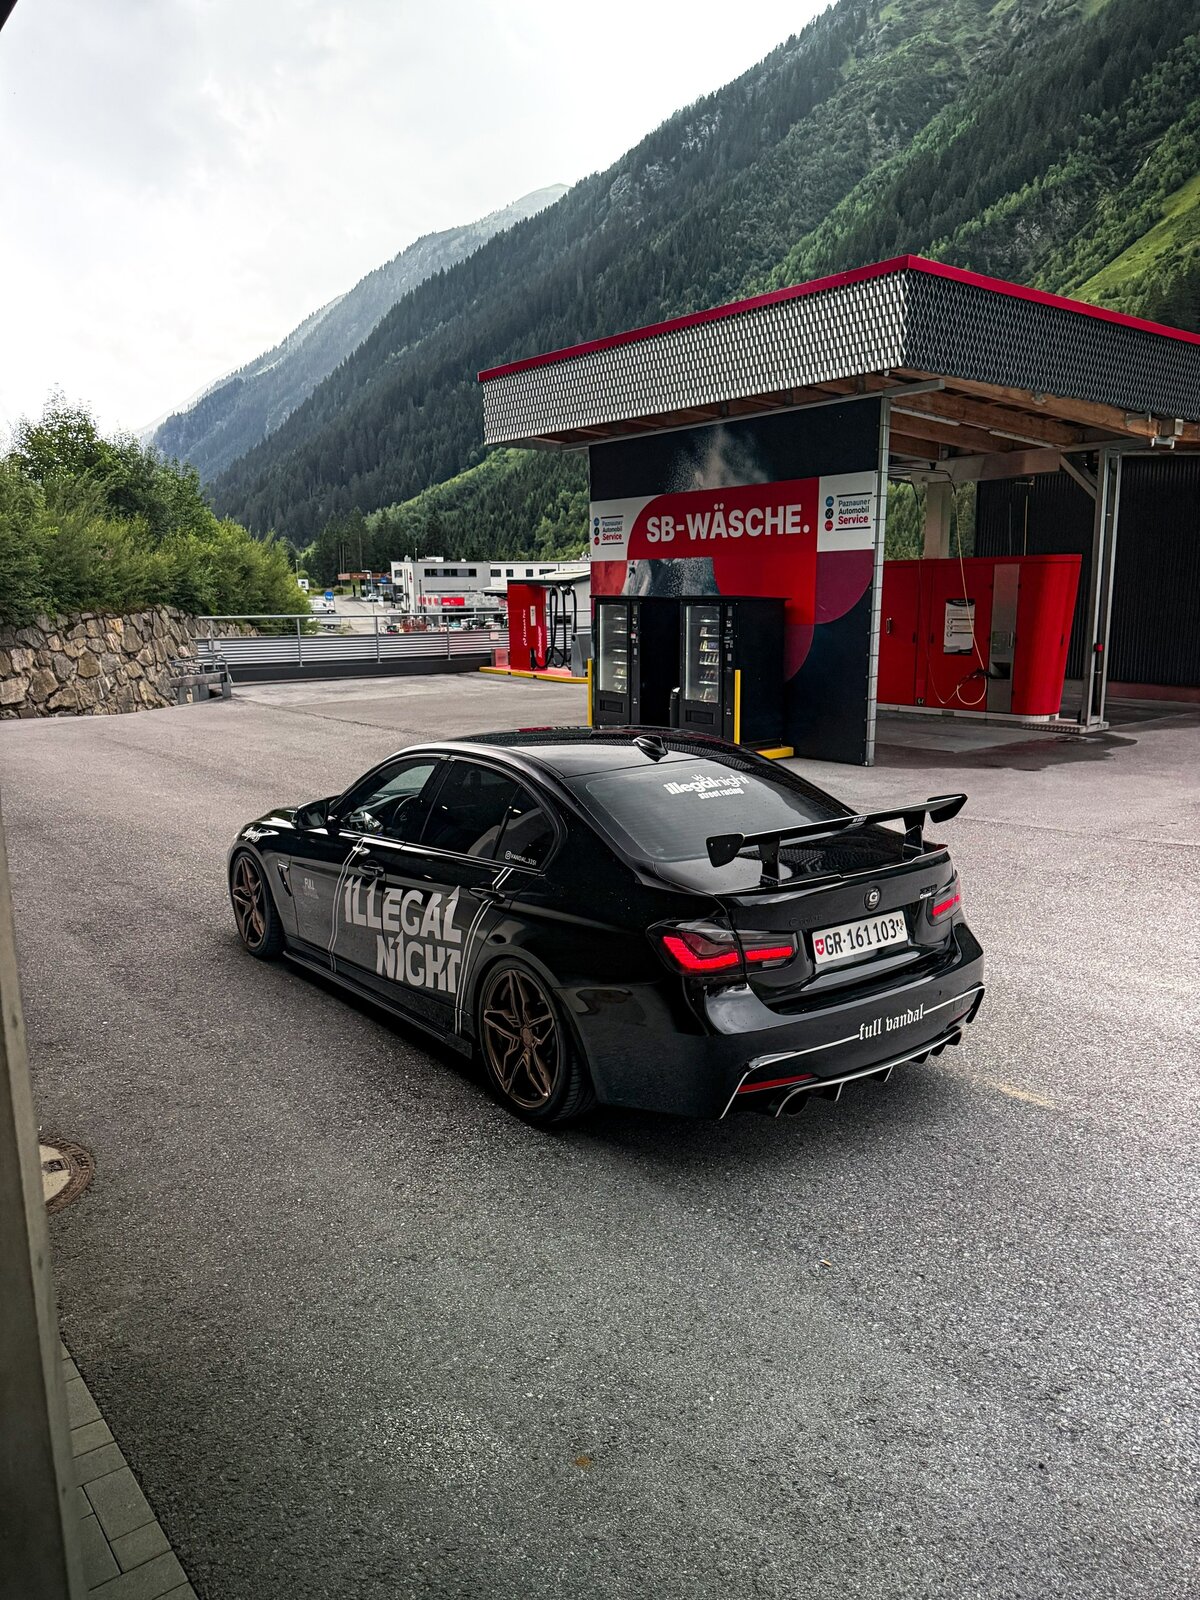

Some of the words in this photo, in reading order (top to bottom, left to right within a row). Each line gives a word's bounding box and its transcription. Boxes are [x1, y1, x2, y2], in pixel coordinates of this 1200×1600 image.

[838, 498, 871, 507] Paznauner
[838, 506, 870, 515] Automobil
[646, 503, 810, 543] SB-WÄSCHE.
[838, 514, 869, 525] Service
[602, 533, 622, 541] Service
[698, 790, 721, 800] street
[720, 787, 745, 797] racing
[344, 874, 462, 944] ILLEGAL
[376, 931, 461, 994] NIGHT
[859, 1017, 882, 1040] full
[886, 1003, 924, 1031] vandal
